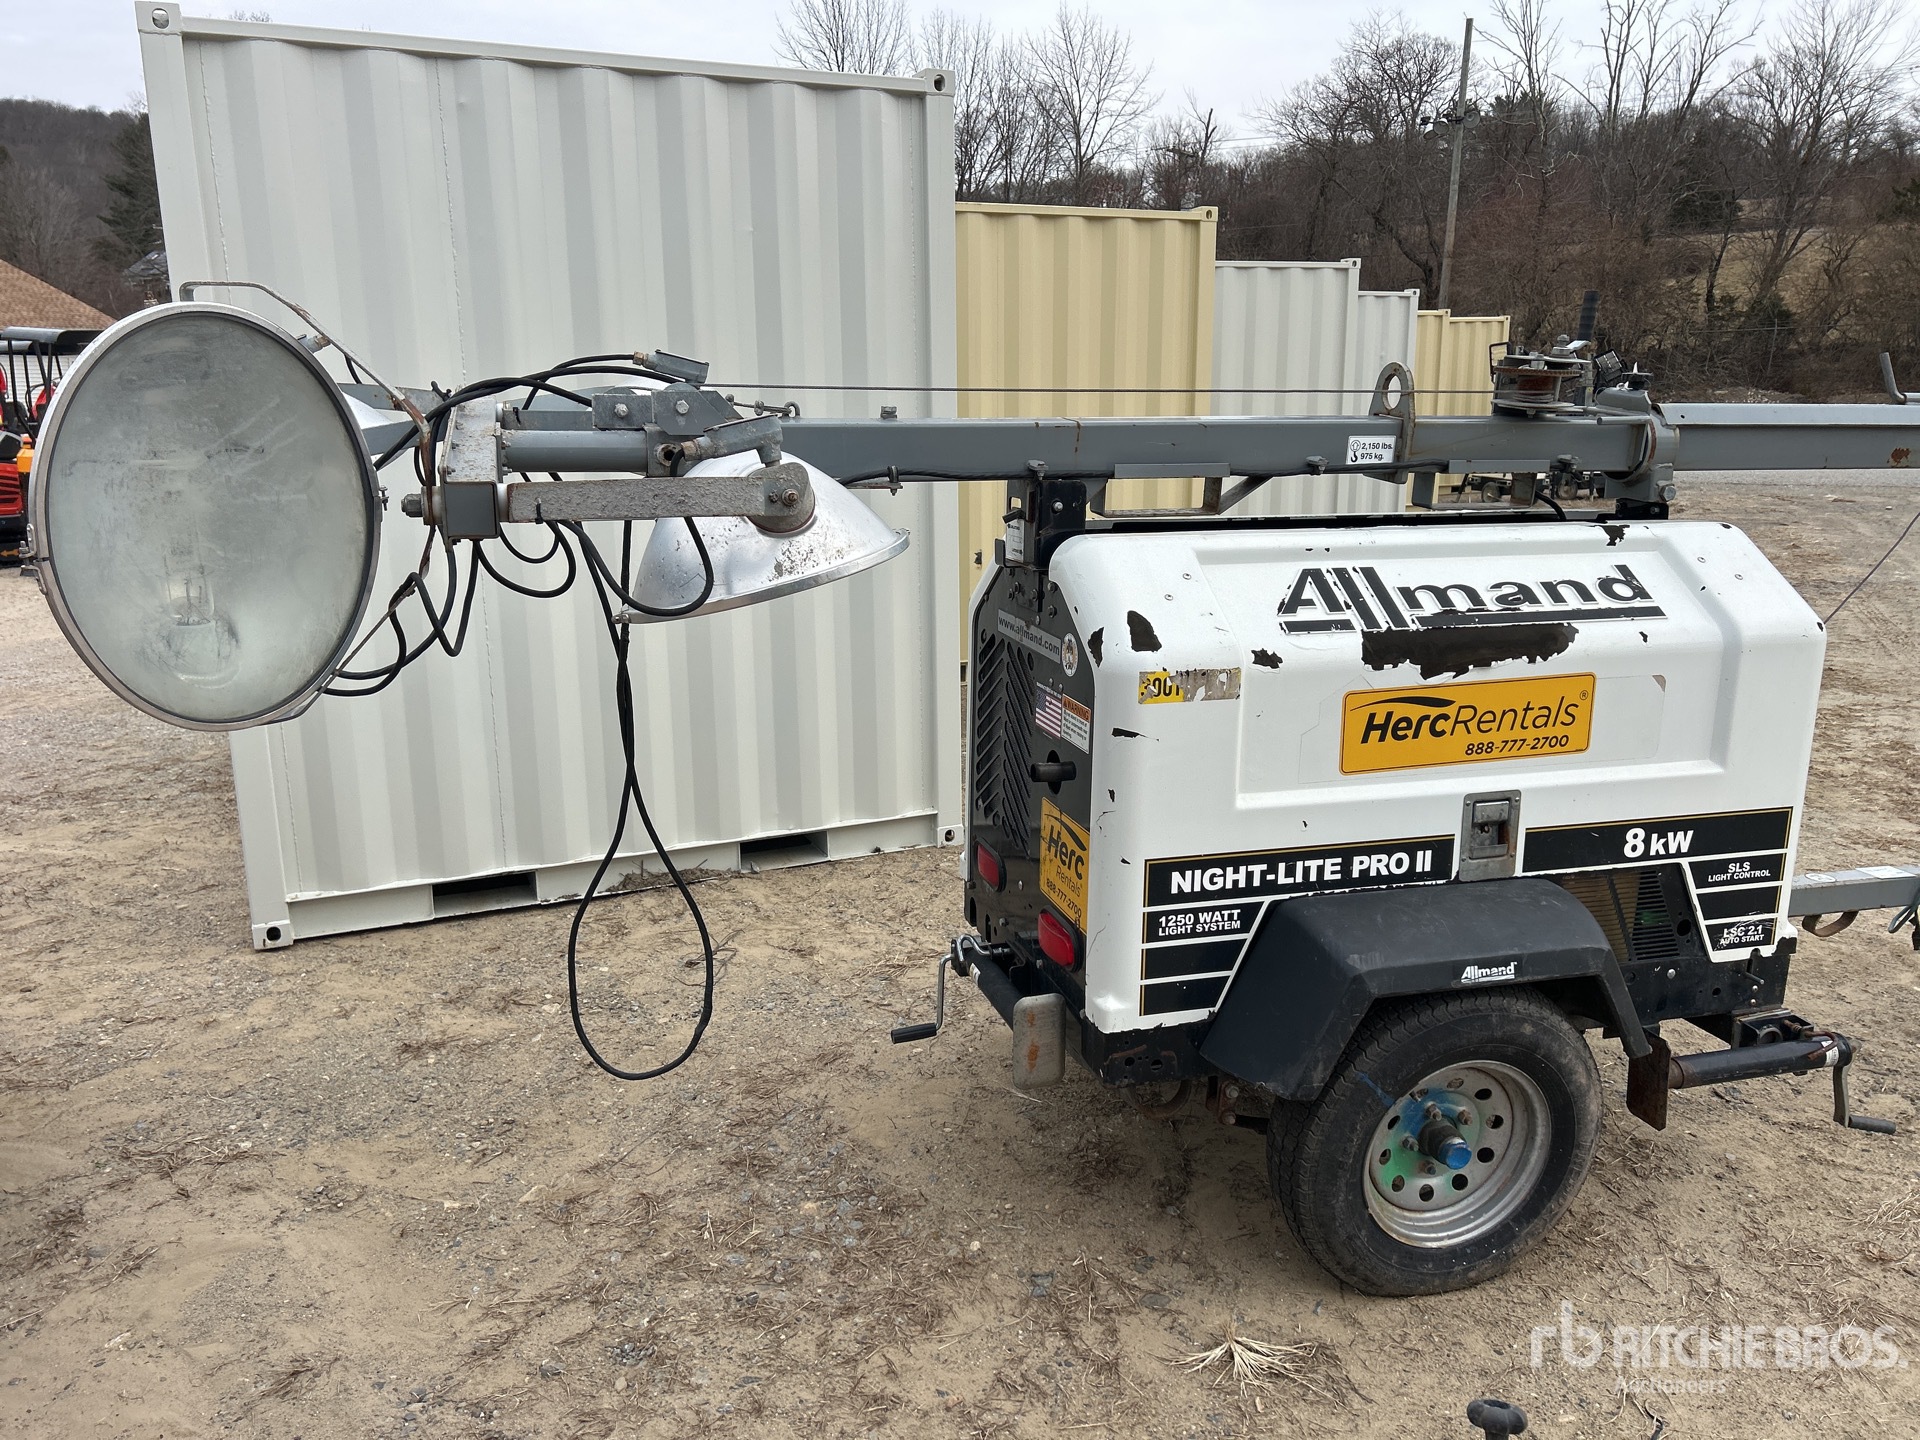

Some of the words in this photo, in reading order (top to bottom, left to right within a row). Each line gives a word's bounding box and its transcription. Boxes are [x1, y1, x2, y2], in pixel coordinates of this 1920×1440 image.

[1360, 452, 1373, 460] 975
[1361, 442, 1381, 451] 2,150
[1278, 564, 1655, 631] Allmand
[998, 616, 1060, 656] www.allmand.com
[1067, 700, 1089, 721] WARNING
[1465, 734, 1570, 756] 888-777-2700
[1047, 824, 1085, 881] Herc
[1623, 827, 1646, 858] 8
[1649, 829, 1694, 856] kW
[1171, 857, 1342, 894] NIGHT-LITE
[1352, 852, 1410, 878] PRO
[1415, 850, 1433, 872] II
[1708, 872, 1732, 882] LIGHT
[1733, 869, 1771, 880] CONTROL
[1727, 861, 1751, 873] SLS
[1055, 865, 1081, 898] Rentals
[1046, 878, 1082, 918] 888-777-2700
[1158, 912, 1194, 928] 1250
[1198, 909, 1241, 924] WATT
[1158, 925, 1193, 936] LIGHT
[1195, 920, 1241, 933] SYSTEM
[1719, 936, 1740, 945] AUTO
[1741, 934, 1765, 942] START
[1723, 927, 1746, 938] LSC
[1747, 925, 1763, 935] 2.1
[1461, 961, 1516, 980] Allmand
